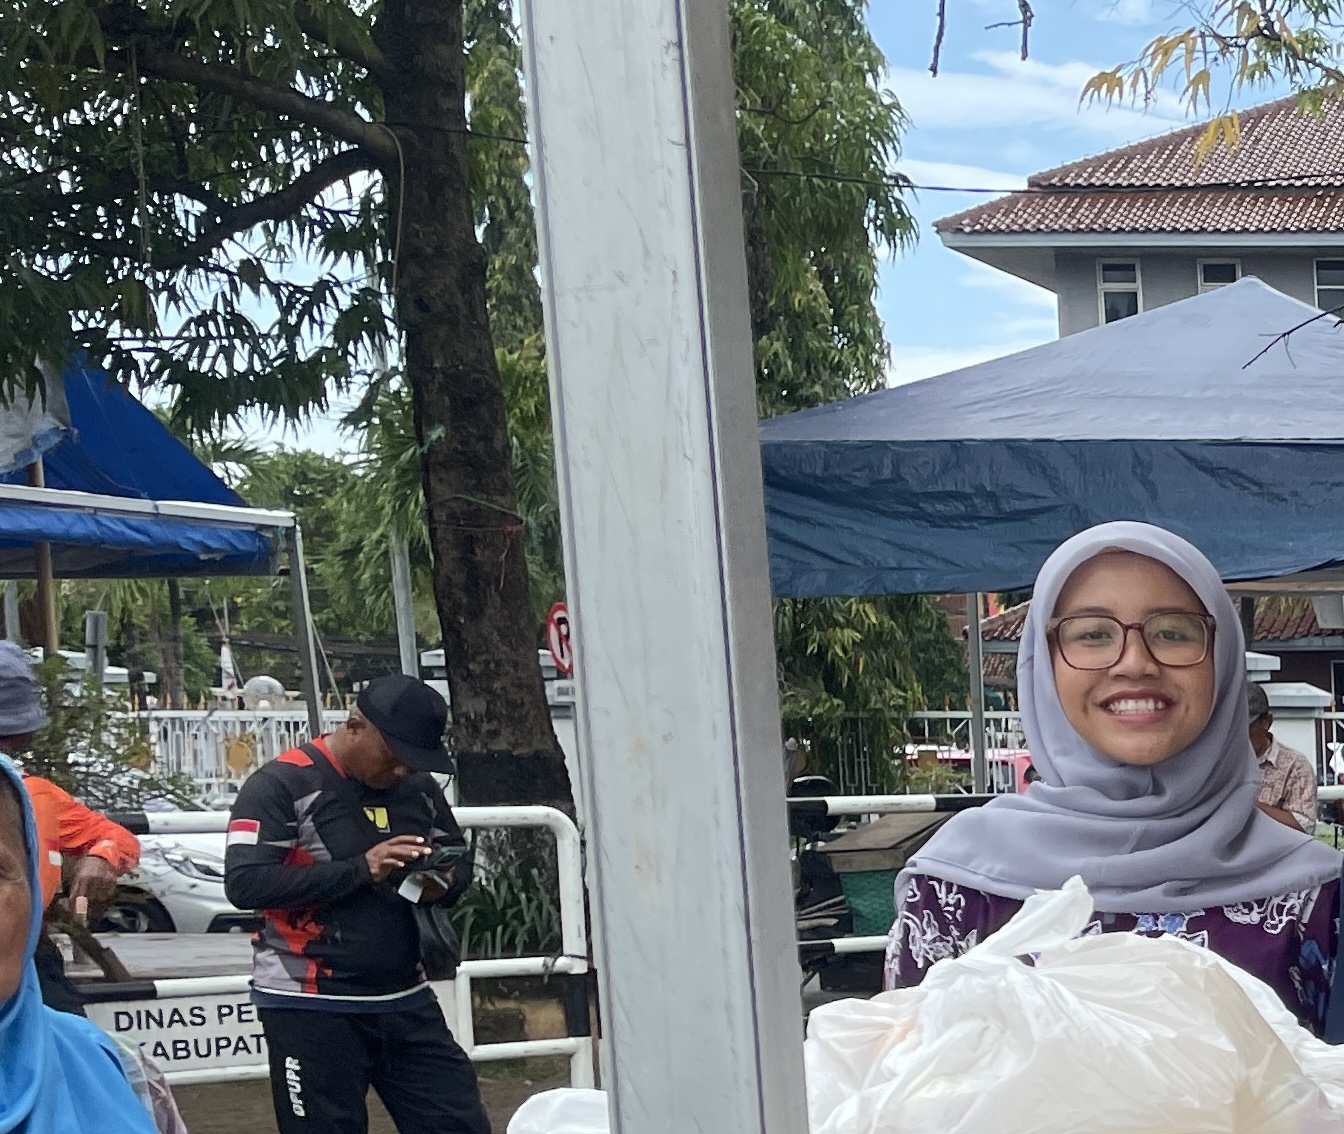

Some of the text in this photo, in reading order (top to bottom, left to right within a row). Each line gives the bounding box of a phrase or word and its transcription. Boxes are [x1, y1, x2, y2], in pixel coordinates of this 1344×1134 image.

[114, 1002, 262, 1032] DINAS PE
[139, 1034, 267, 1062] ABUPAT
